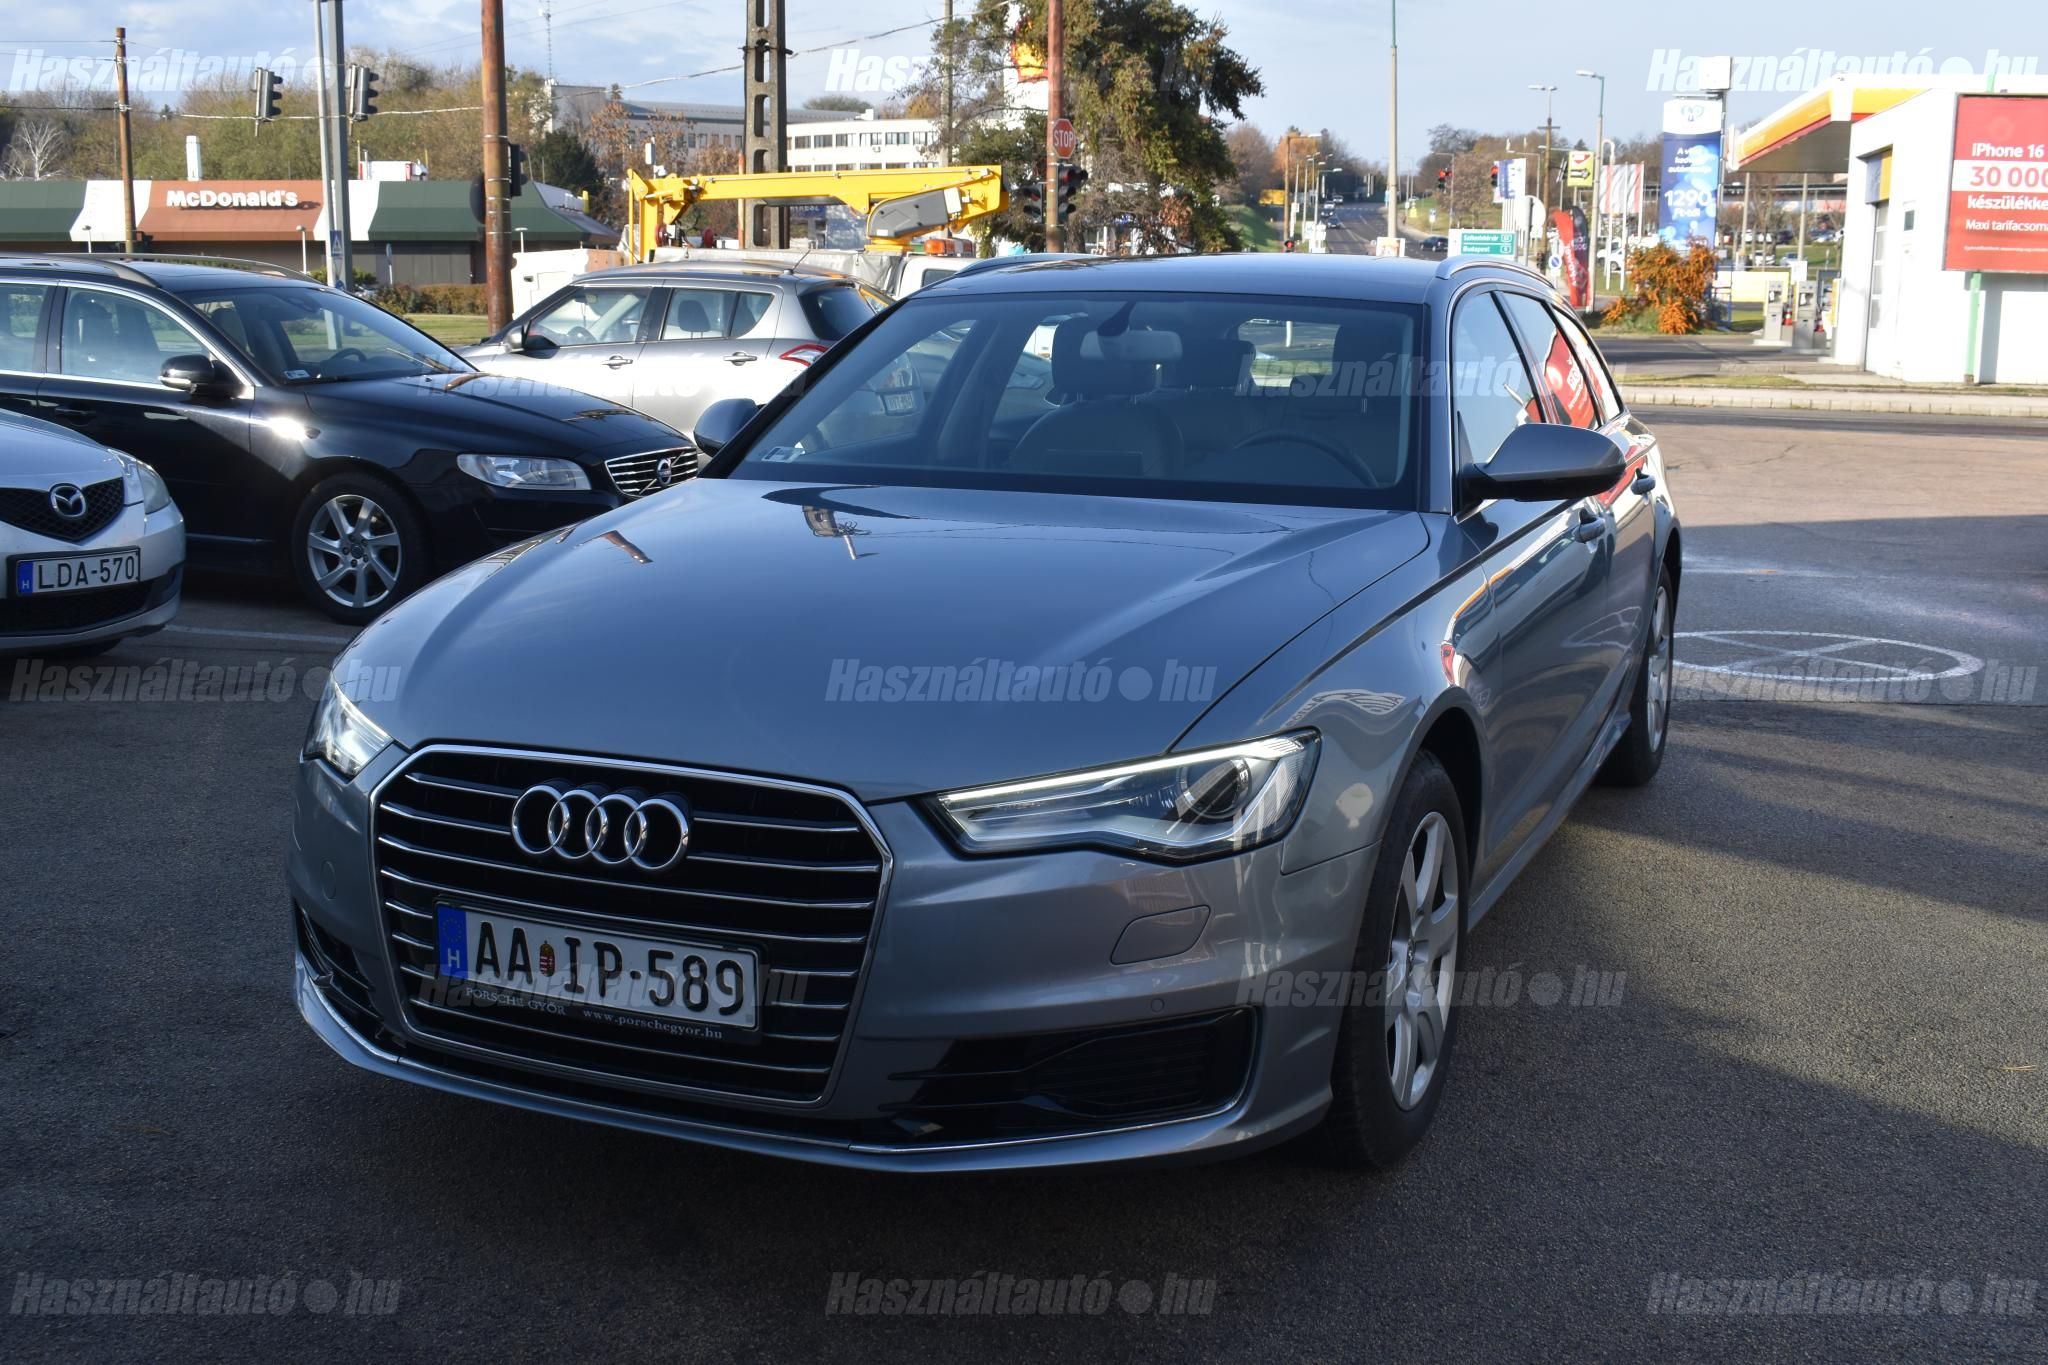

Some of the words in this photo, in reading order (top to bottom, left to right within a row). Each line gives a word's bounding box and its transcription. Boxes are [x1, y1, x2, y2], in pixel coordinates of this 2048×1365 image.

[1053, 130, 1074, 148] STOP
[2027, 144, 2045, 159] 16
[1969, 166, 2002, 187] 30
[166, 190, 298, 207] McDonald's
[1664, 189, 1713, 207] 1290
[1965, 219, 1990, 231] Maxi
[1991, 219, 2048, 232] tarifacsom
[38, 556, 135, 589] LDA-570
[22, 580, 30, 590] H
[447, 947, 461, 969] H
[465, 987, 525, 1008] PORSCHE
[527, 1000, 567, 1017] GYŐR
[582, 1007, 724, 1040] www.porschegyor.hu
